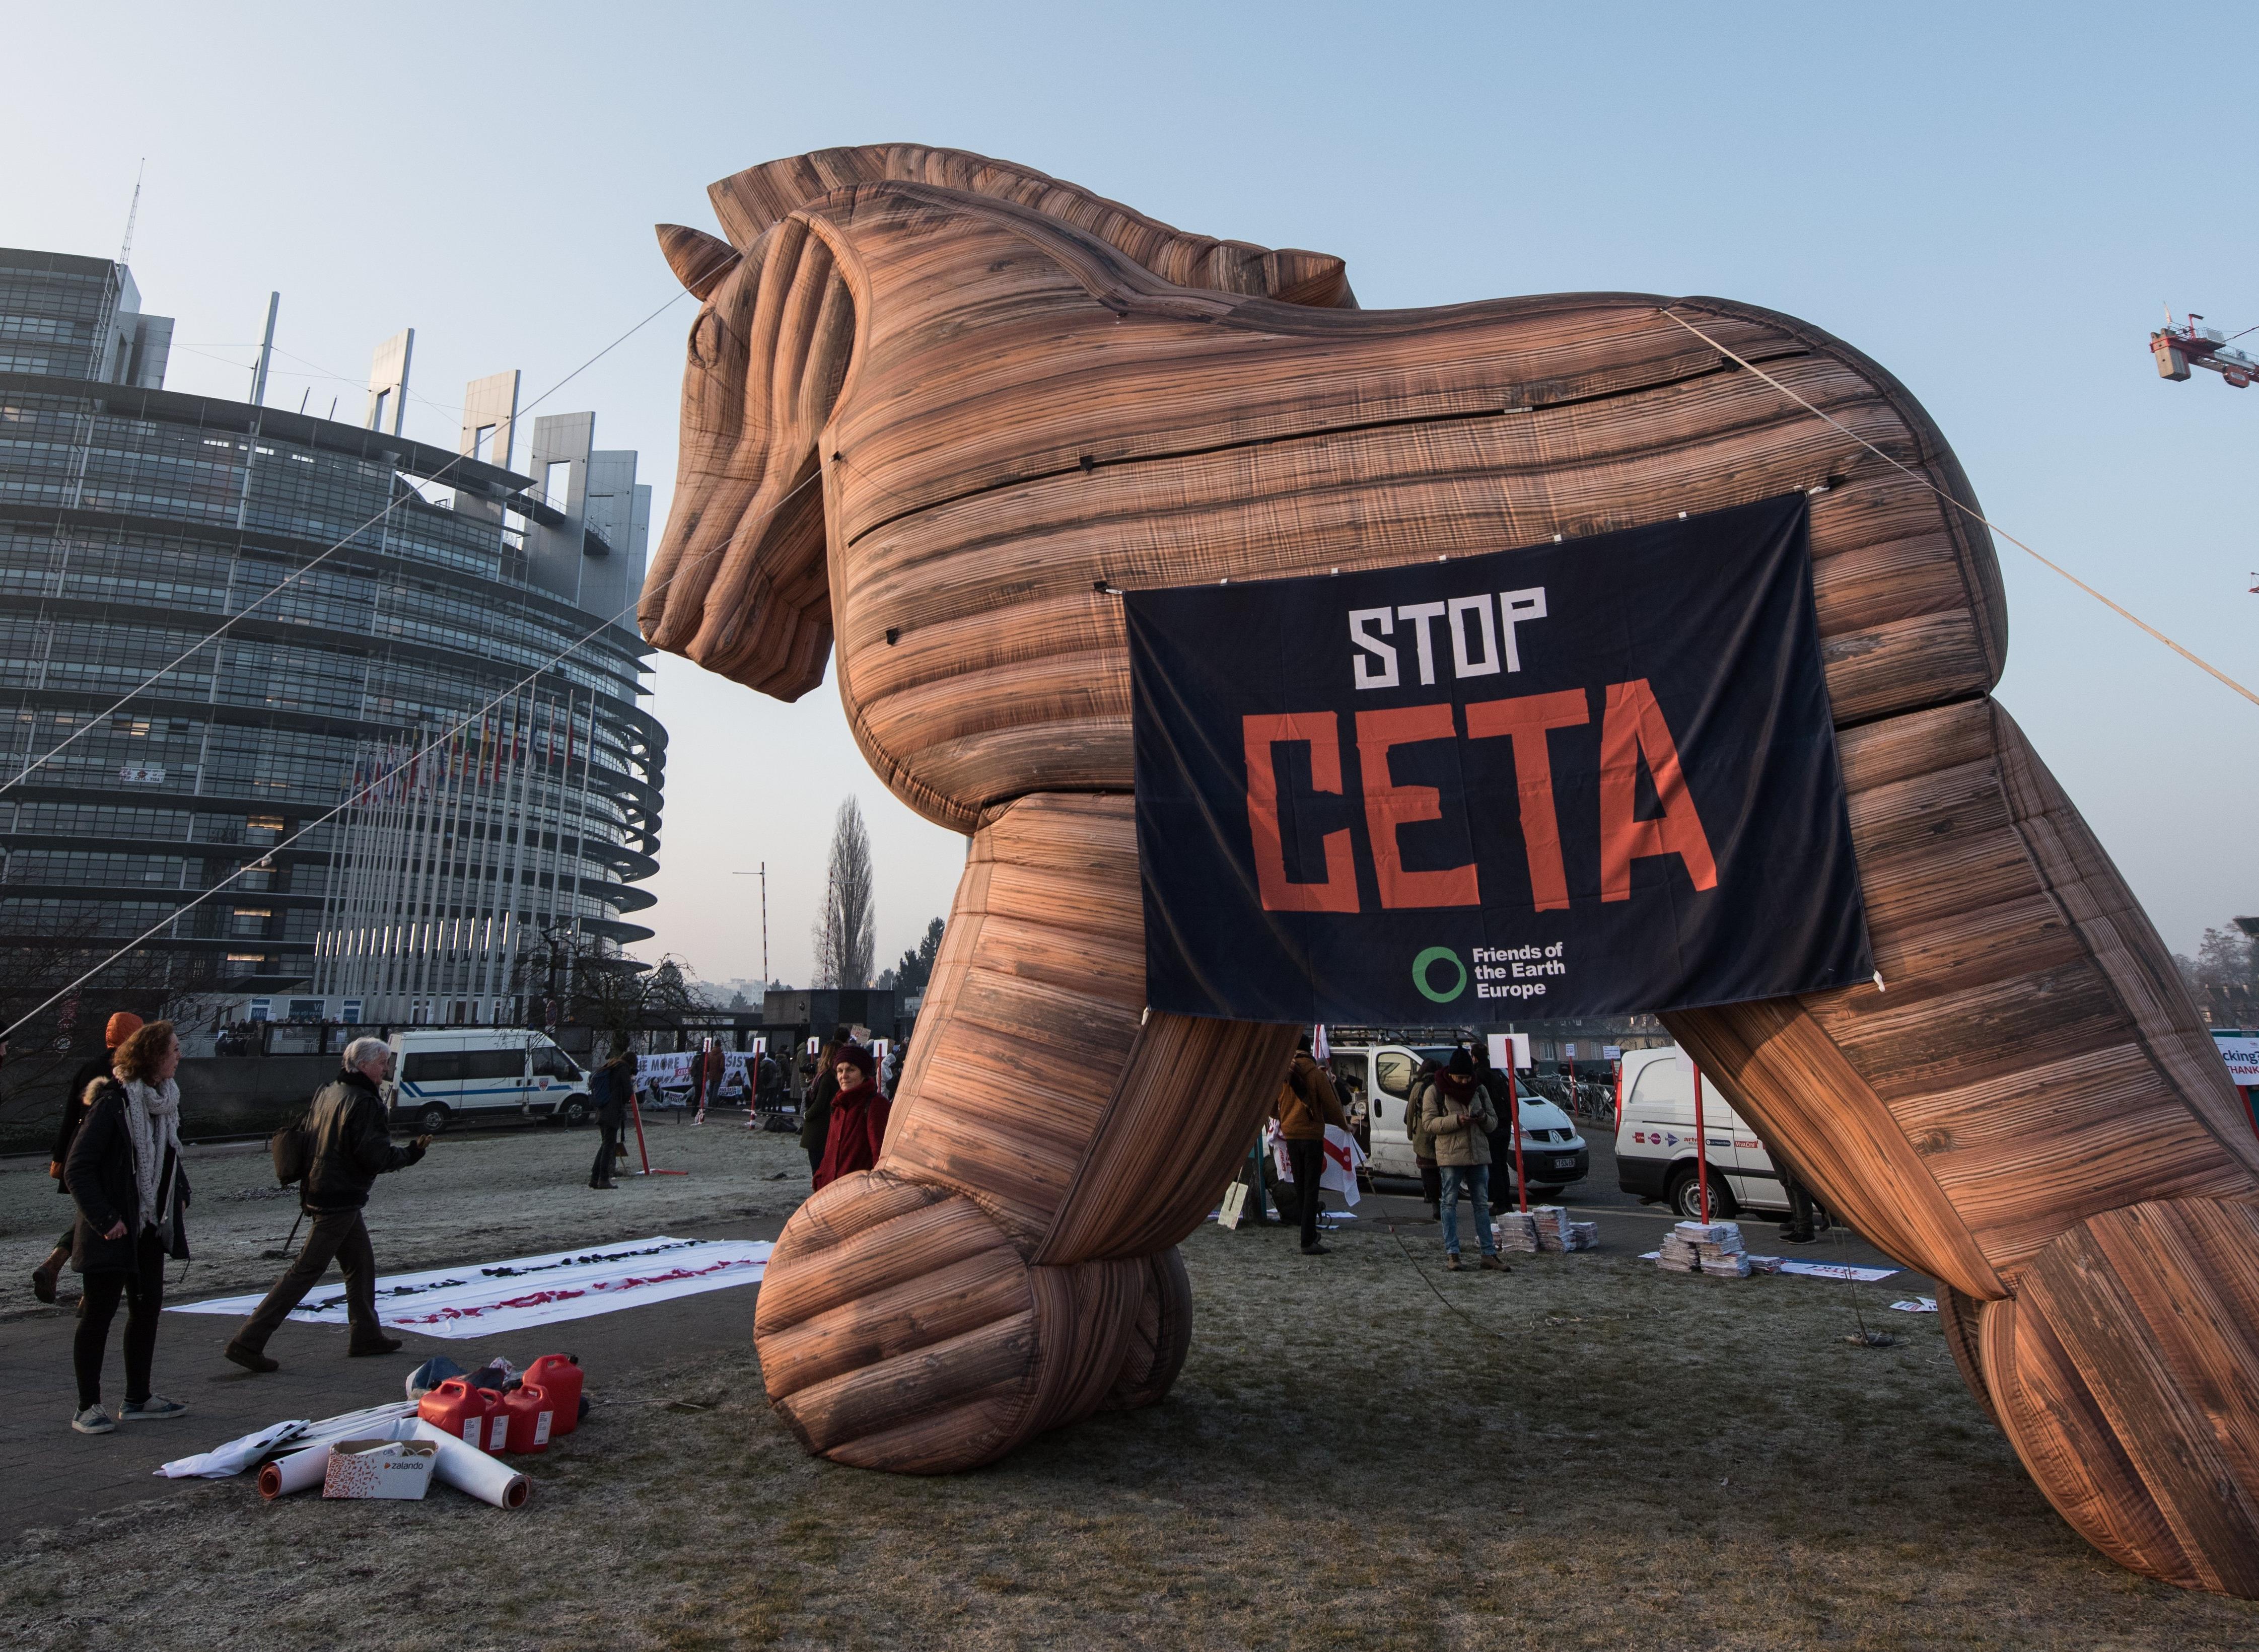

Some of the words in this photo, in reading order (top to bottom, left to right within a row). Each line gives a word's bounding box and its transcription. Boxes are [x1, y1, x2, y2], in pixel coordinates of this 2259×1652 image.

[1349, 587, 1547, 689] STOP
[1242, 678, 1718, 913] CETA
[1472, 945, 1541, 963] Friends
[1544, 942, 1563, 957] of
[1474, 965, 1506, 980] the
[1512, 960, 1566, 977] Earth
[1476, 982, 1546, 999] Europe
[651, 1057, 680, 1071] MORE
[391, 1462, 423, 1470] zalando
